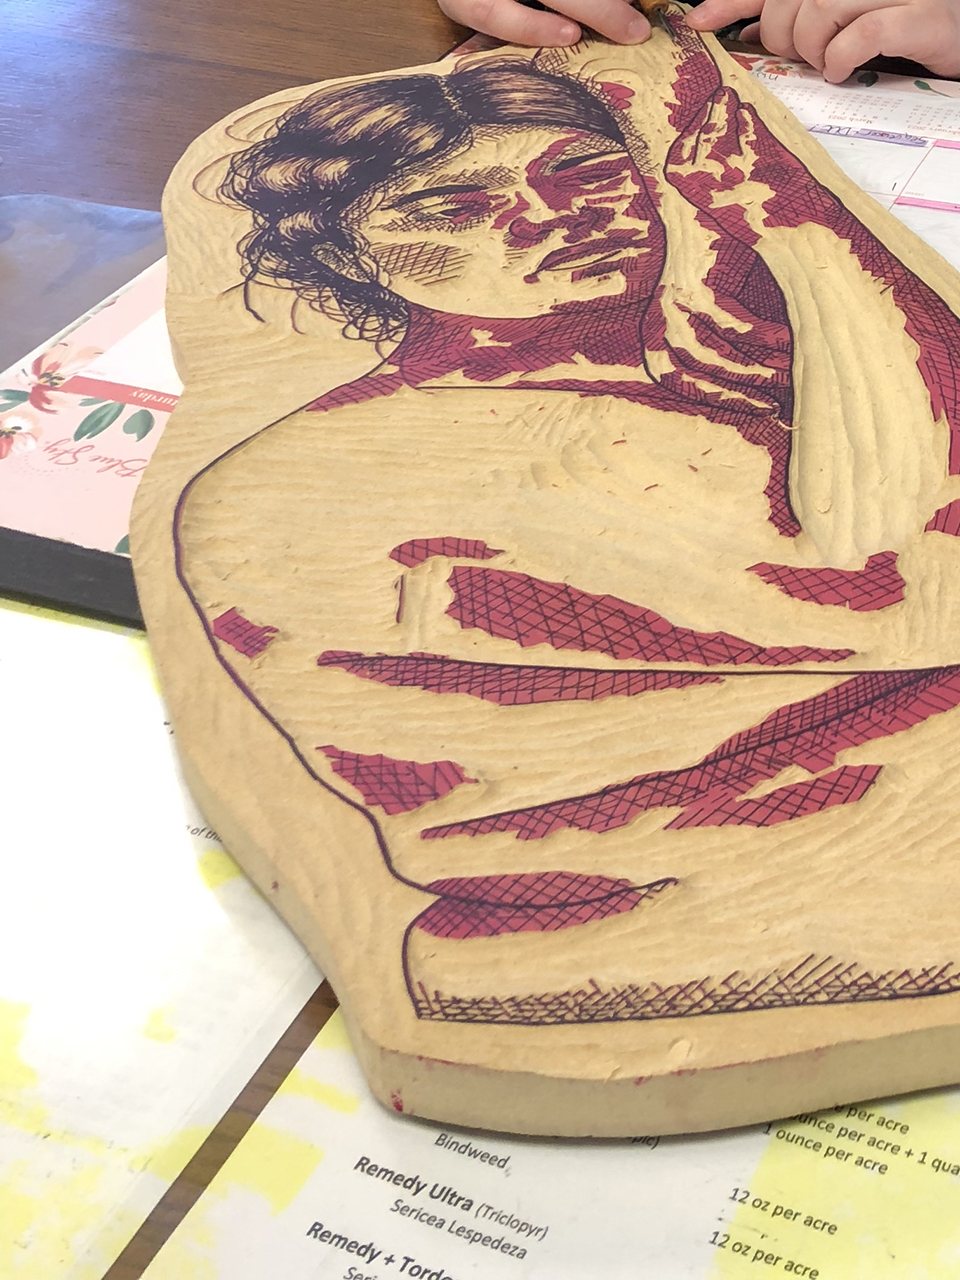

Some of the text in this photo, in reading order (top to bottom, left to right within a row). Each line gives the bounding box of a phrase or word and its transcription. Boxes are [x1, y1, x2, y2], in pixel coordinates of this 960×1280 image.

[88, 455, 148, 478] Blue
[836, 1122, 864, 1144] per
[866, 1134, 902, 1158] acre
[904, 1147, 915, 1159] +
[917, 1150, 928, 1165] 1
[846, 1104, 868, 1122] per
[876, 1111, 911, 1136] acre
[434, 1132, 511, 1170] Bindweed
[763, 1122, 890, 1176] 1 ounce per acre
[354, 1156, 550, 1242] Remedy Ultra (Triclopyr)
[728, 1188, 839, 1236] 12 oz per acre
[306, 1220, 396, 1266] Remedy +
[389, 1198, 528, 1260] Sericea Lespedeza
[708, 1231, 820, 1280] 12 oz per acre
